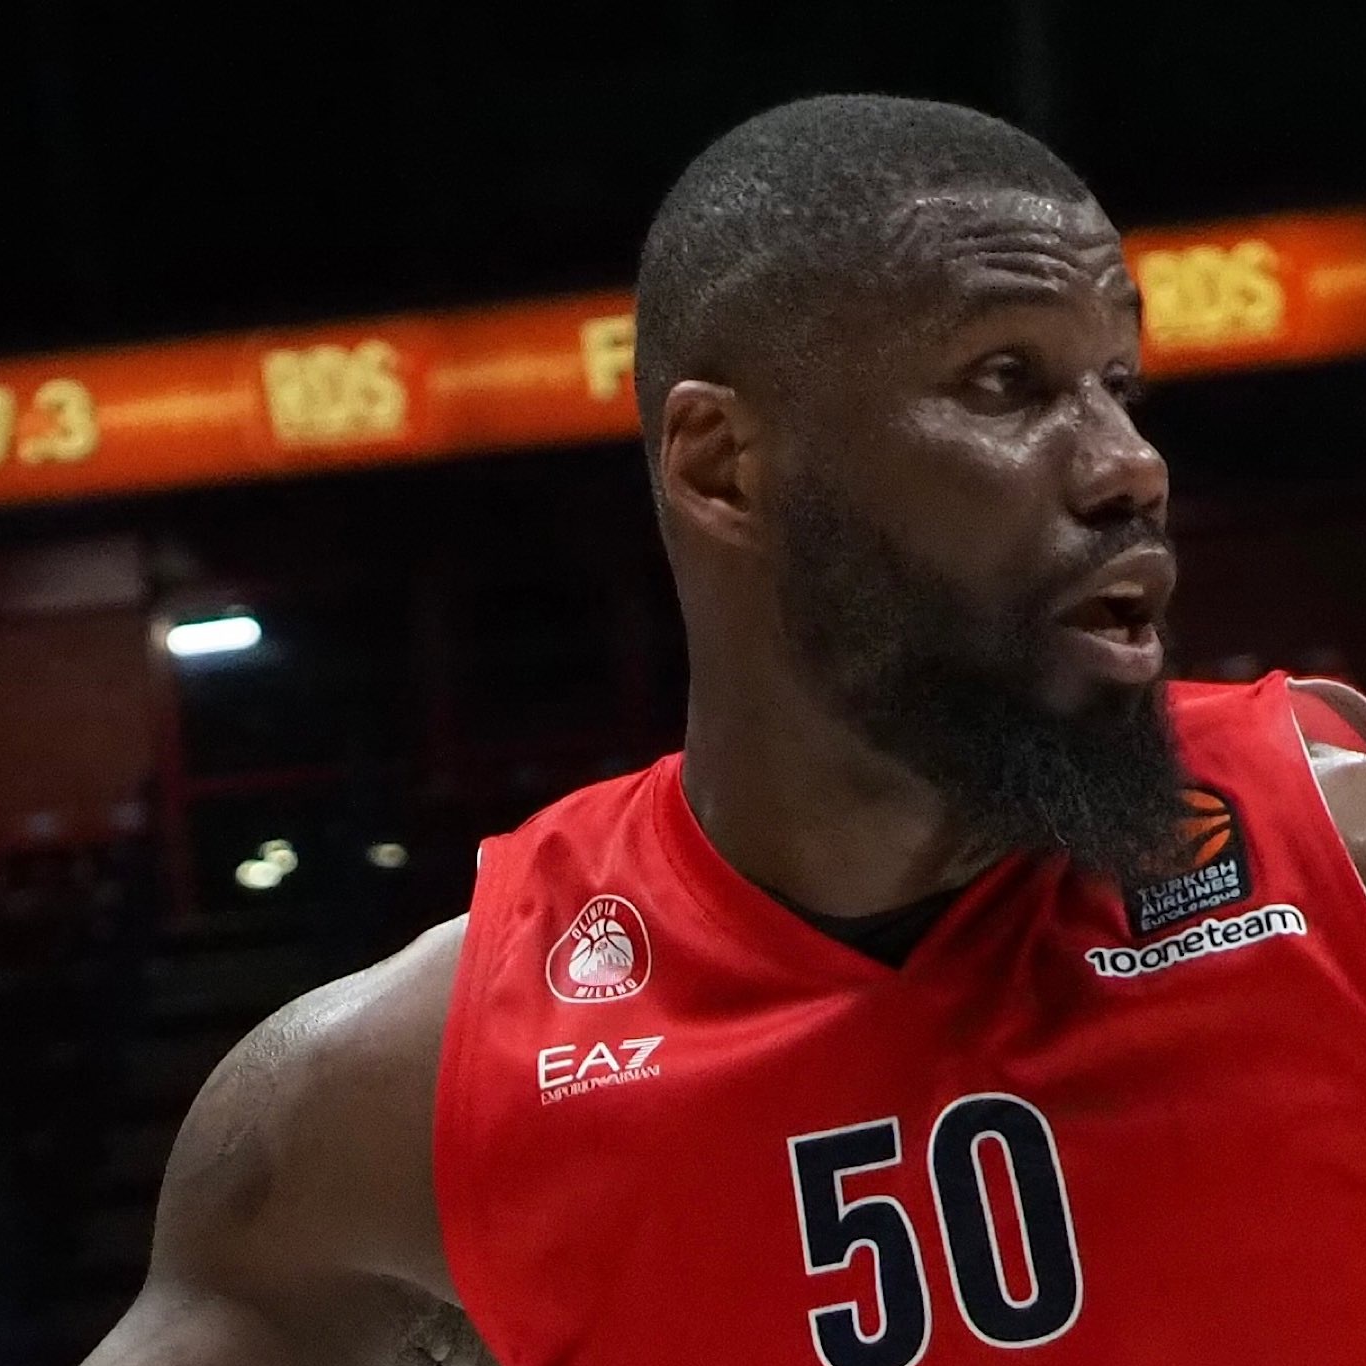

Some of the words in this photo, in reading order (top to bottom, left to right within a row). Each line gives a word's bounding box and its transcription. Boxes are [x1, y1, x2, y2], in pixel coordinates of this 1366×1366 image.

[579, 315, 635, 400] F
[1137, 860, 1237, 903] TURKISH
[1141, 874, 1240, 916] AIRLINES
[571, 901, 618, 940] OLIMPIA
[574, 978, 637, 998] MILANO
[538, 1035, 665, 1089] EA7
